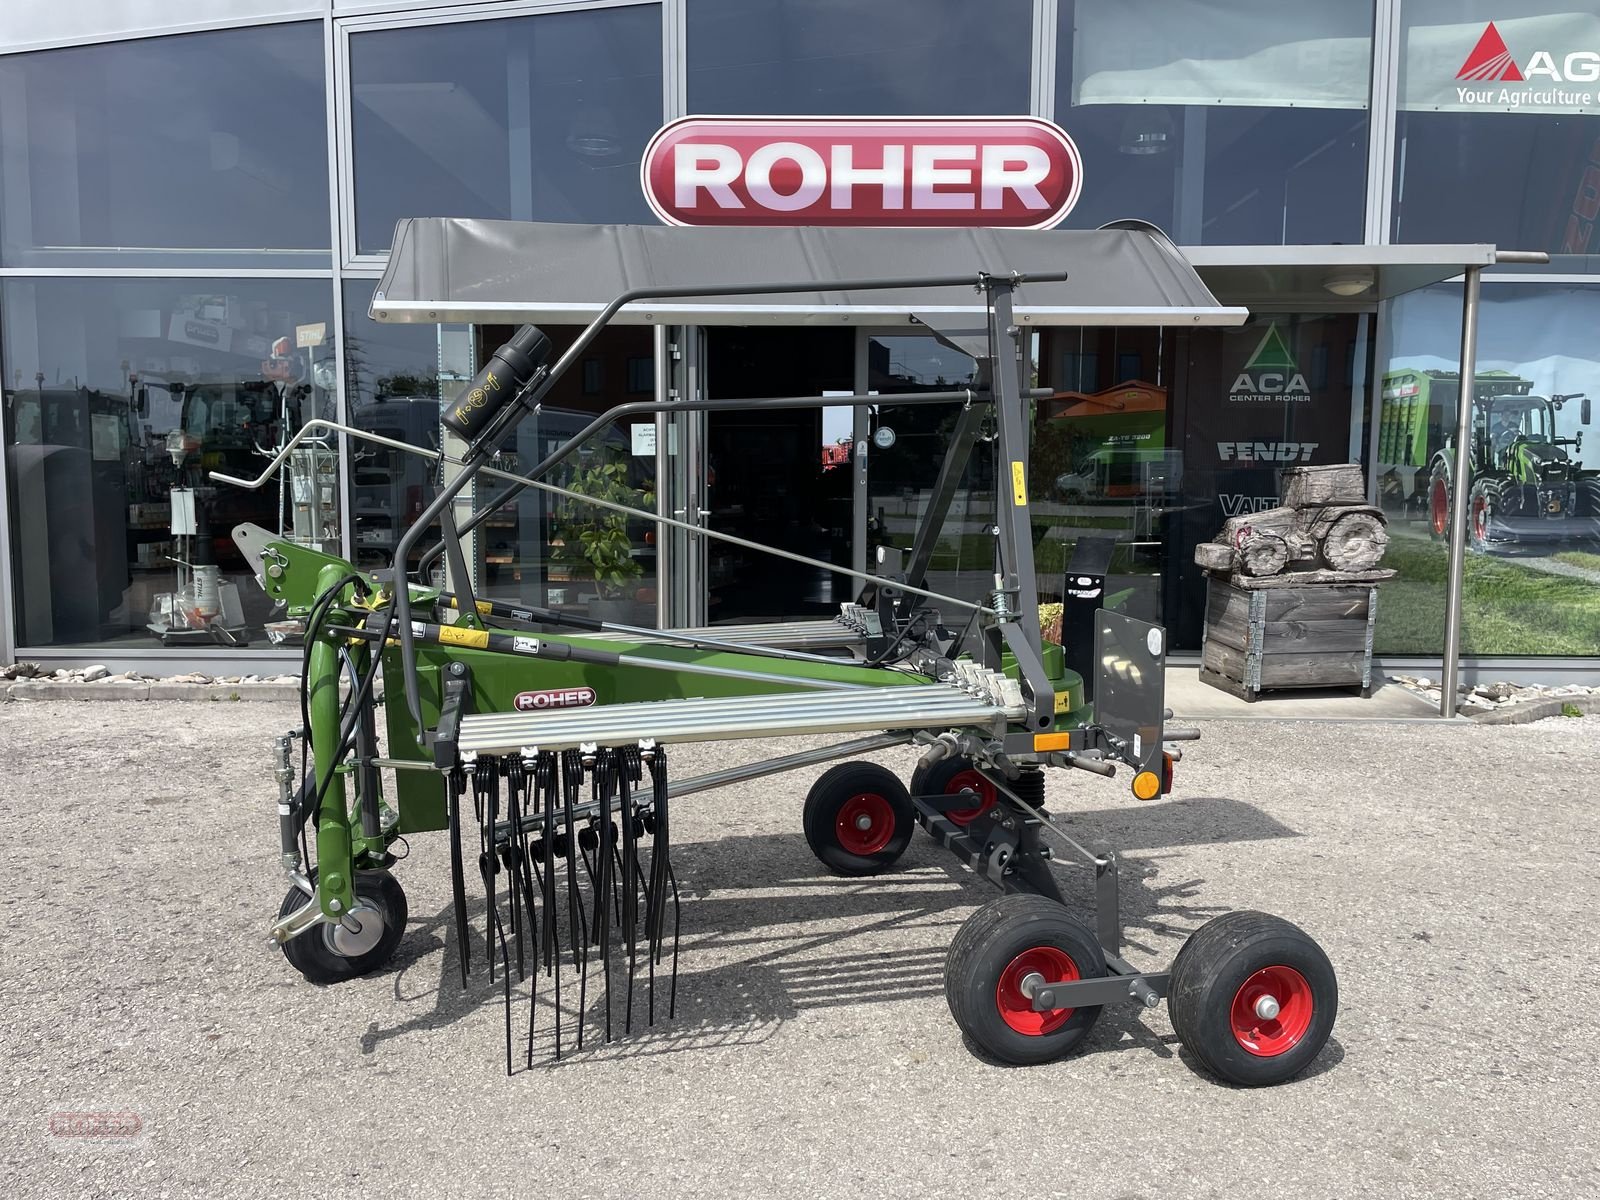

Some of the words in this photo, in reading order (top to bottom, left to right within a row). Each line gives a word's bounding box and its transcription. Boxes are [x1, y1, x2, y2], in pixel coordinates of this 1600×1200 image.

[1524, 51, 1600, 82] AG
[1457, 88, 1493, 104] Your
[1498, 88, 1591, 108] Agriculture
[674, 141, 1051, 211] ROHER
[1230, 374, 1310, 394] ACA
[1229, 394, 1271, 402] CENTER
[1275, 394, 1311, 402] ROHER
[1217, 442, 1319, 461] FENDT
[1219, 494, 1280, 517] VALT
[519, 691, 592, 709] ROHER
